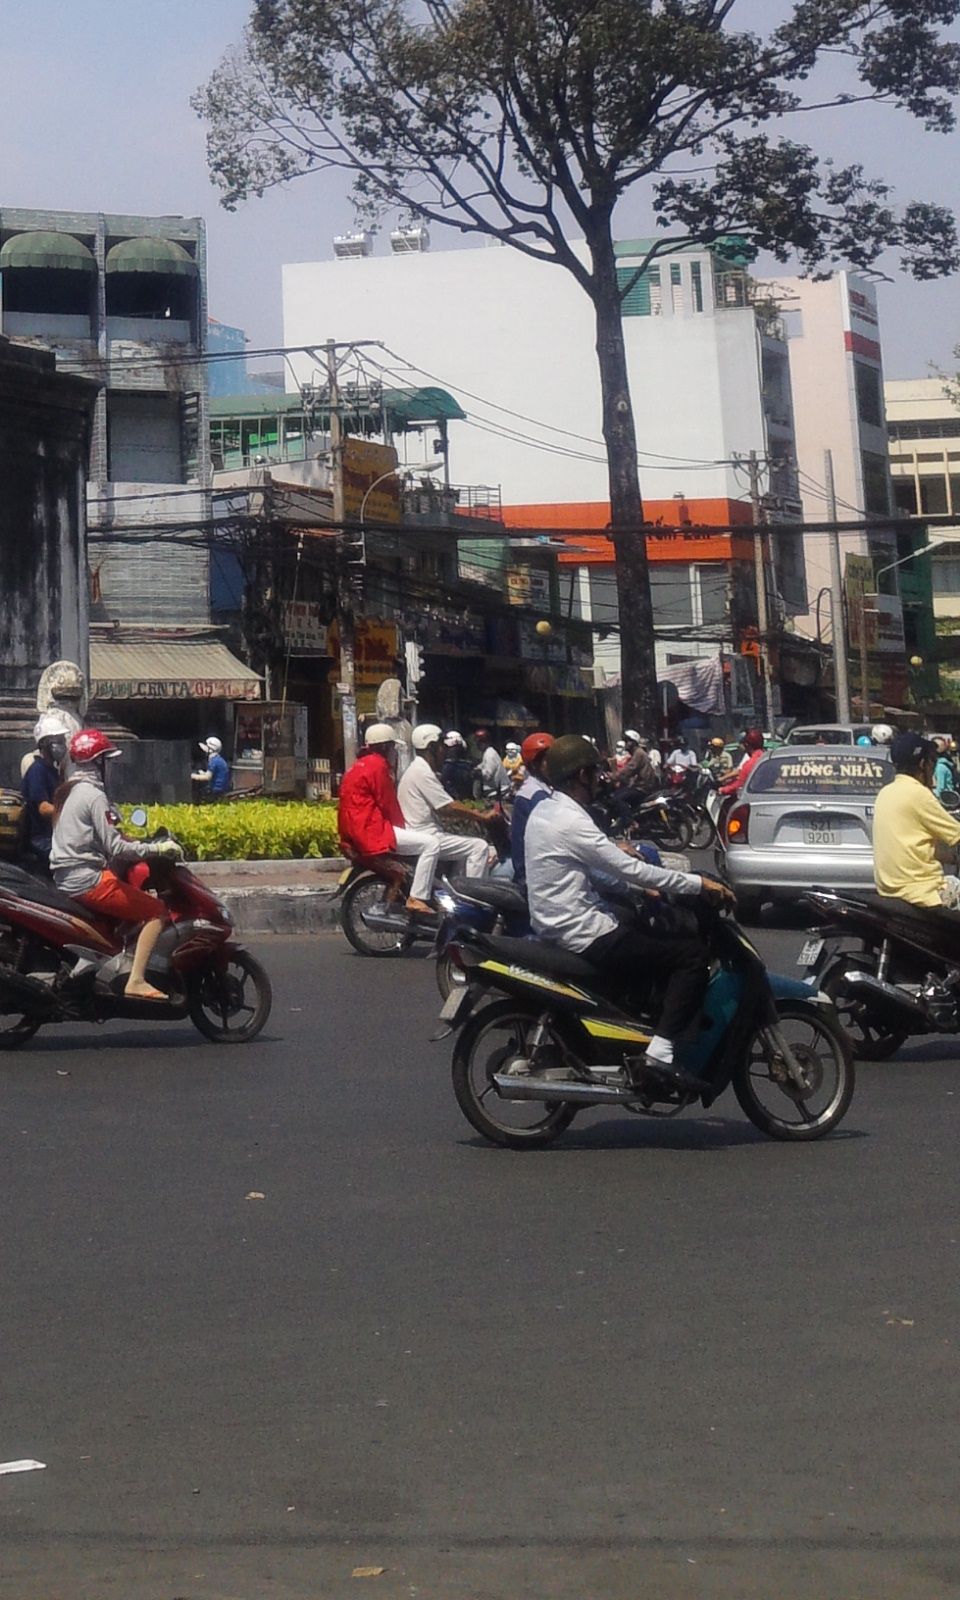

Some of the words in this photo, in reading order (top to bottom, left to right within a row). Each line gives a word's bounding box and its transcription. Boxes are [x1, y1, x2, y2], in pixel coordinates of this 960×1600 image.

[781, 761, 833, 777] THỐNG
[841, 762, 883, 778] NHẤT
[808, 833, 836, 844] 9201
